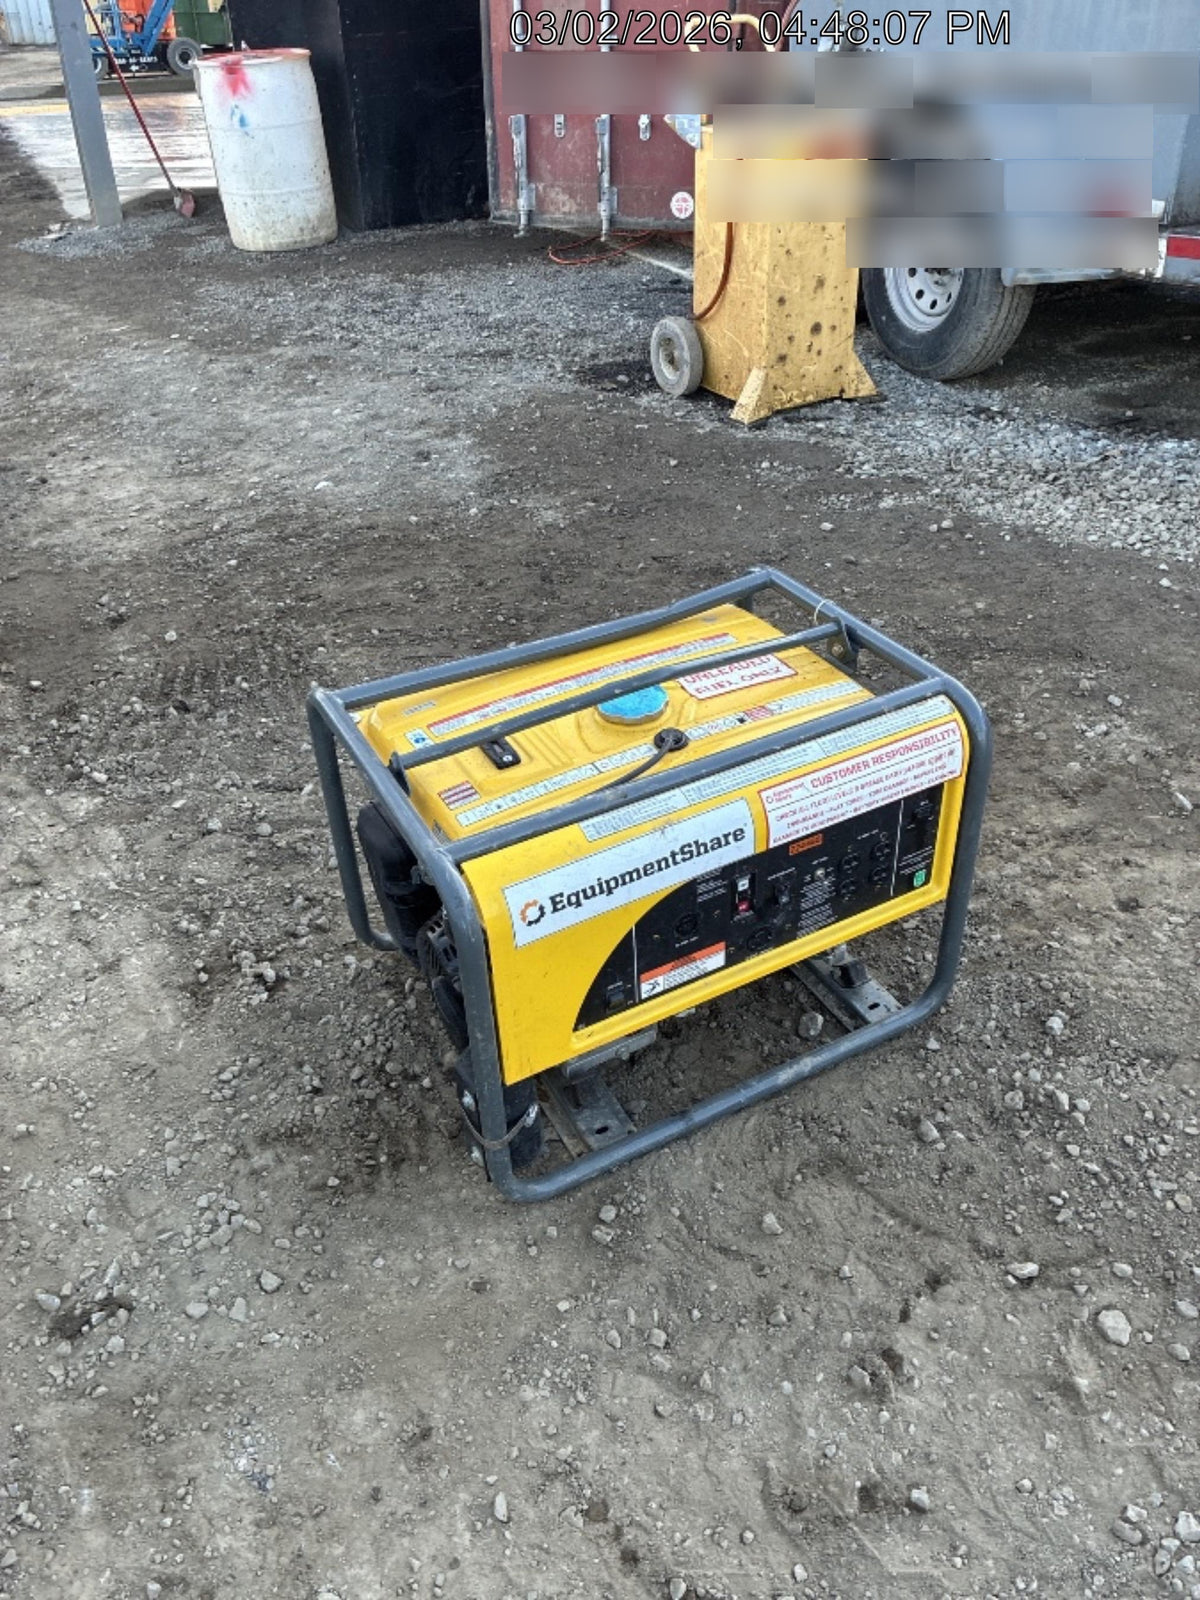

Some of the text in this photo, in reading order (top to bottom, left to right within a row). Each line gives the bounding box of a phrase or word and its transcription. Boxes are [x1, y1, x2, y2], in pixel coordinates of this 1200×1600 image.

[810, 760, 871, 788] CUSTOMER
[872, 728, 959, 766] RESPONSIBILITY
[549, 827, 746, 914] EquipmentShare
